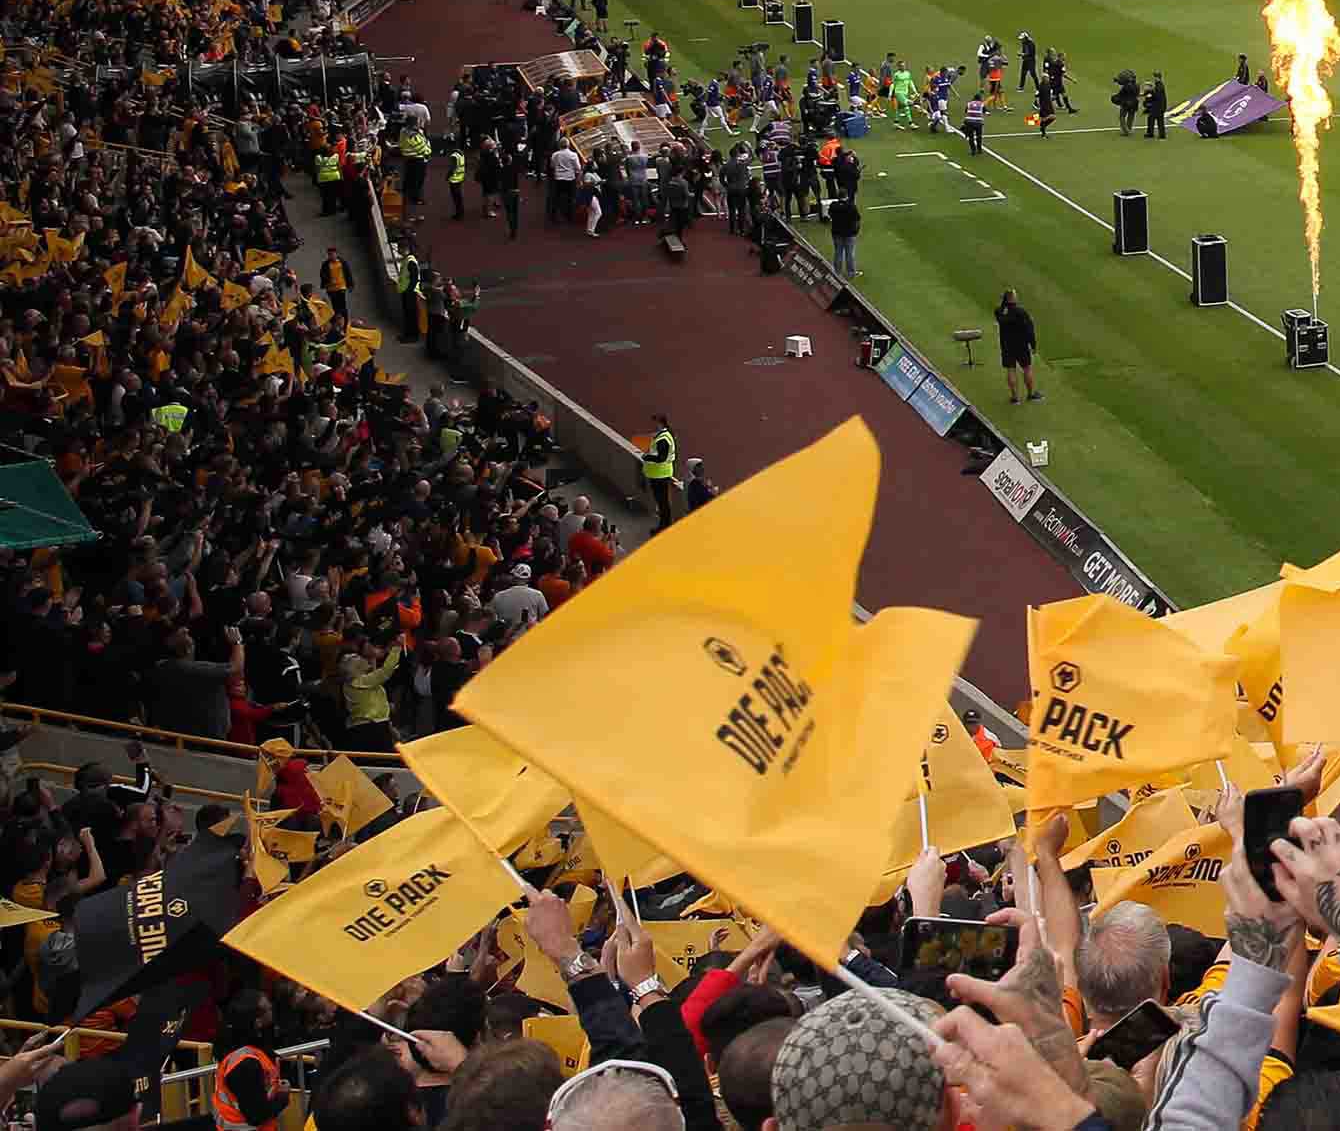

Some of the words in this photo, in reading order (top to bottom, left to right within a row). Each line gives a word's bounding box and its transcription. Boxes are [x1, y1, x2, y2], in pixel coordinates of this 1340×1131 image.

[1083, 551, 1112, 585] GET
[1100, 569, 1139, 607] MORE
[716, 692, 784, 776] ONE
[1039, 697, 1137, 760] PACK
[343, 906, 385, 943] ONE
[387, 862, 453, 928] PACK
